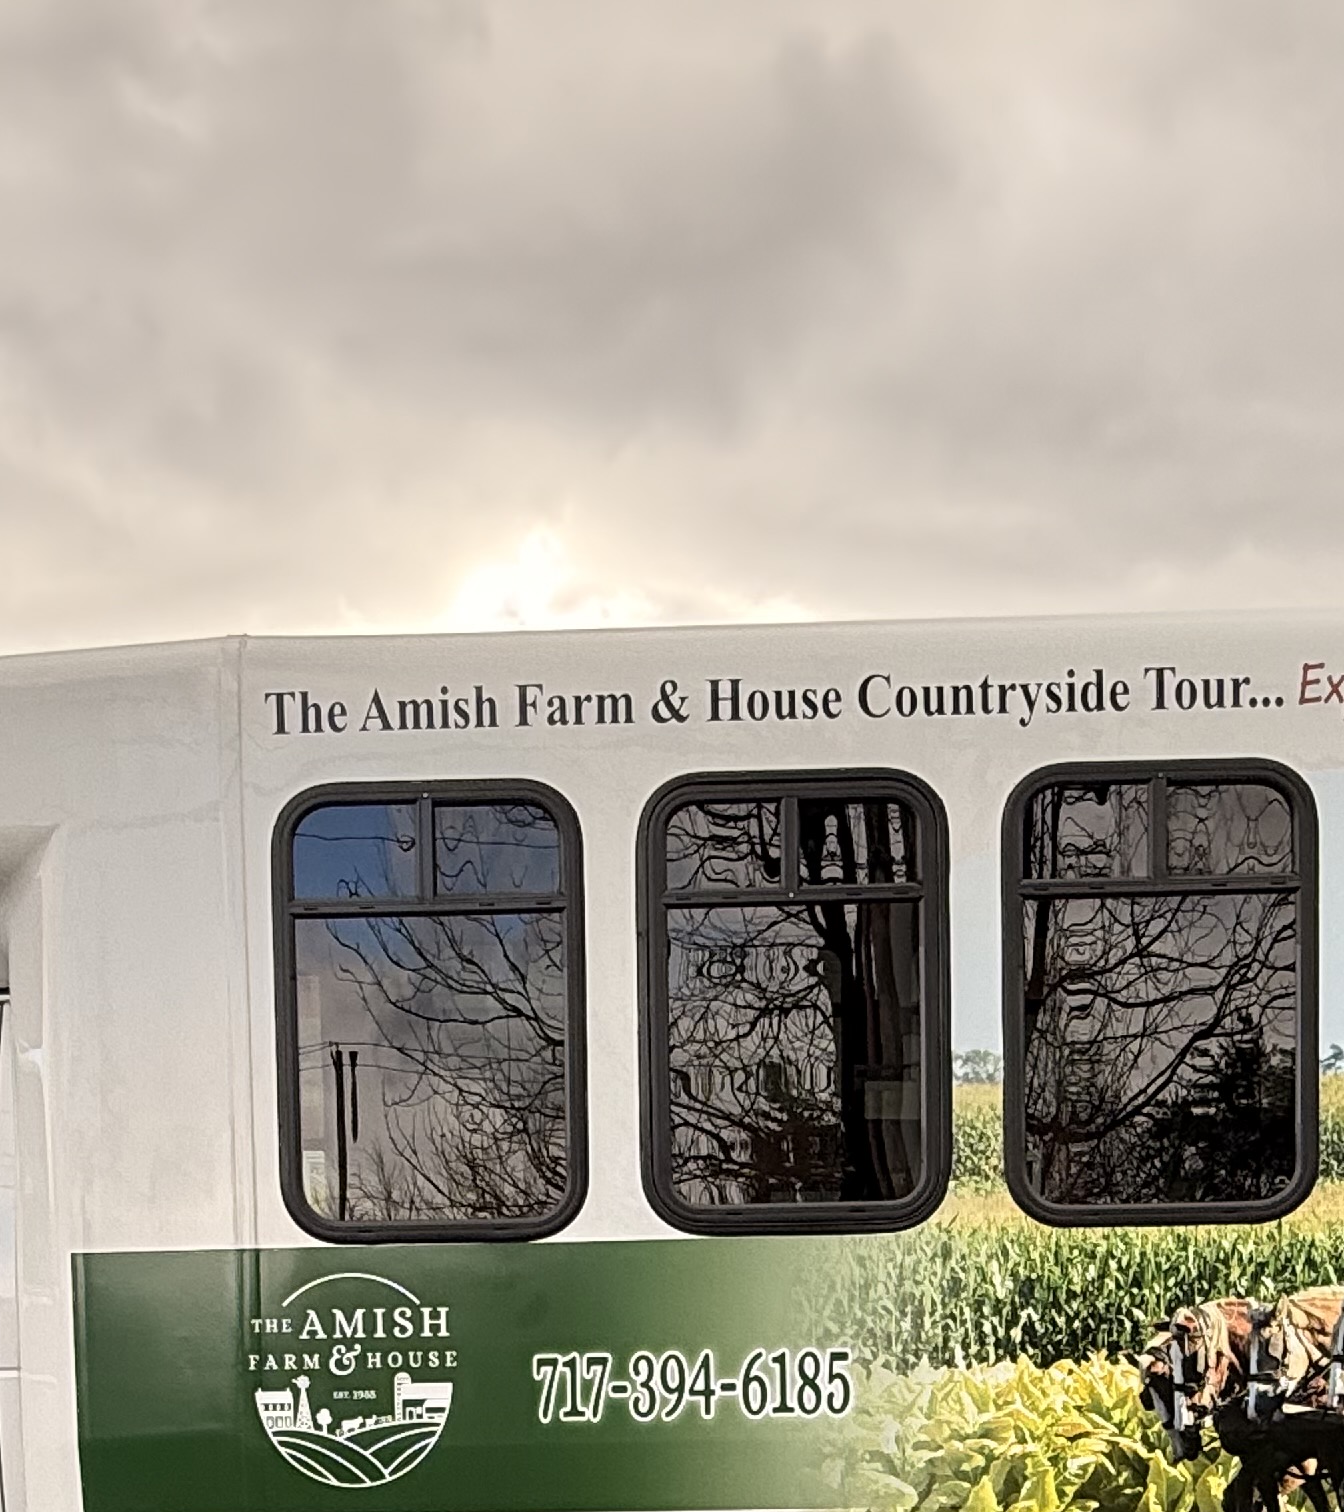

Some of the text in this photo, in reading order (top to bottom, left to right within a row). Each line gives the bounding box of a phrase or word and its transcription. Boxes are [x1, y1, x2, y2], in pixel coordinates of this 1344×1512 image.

[264, 691, 347, 735] The
[359, 685, 499, 733] Amish
[514, 683, 634, 728] Farm
[651, 679, 690, 724] &
[705, 678, 842, 722] House
[858, 669, 1131, 727] Countryside
[1144, 666, 1284, 712] Tour...
[250, 1306, 451, 1340] THE AMISH
[248, 1343, 458, 1375] FARM & HOUSE
[533, 1348, 852, 1423] 717-394-6185
